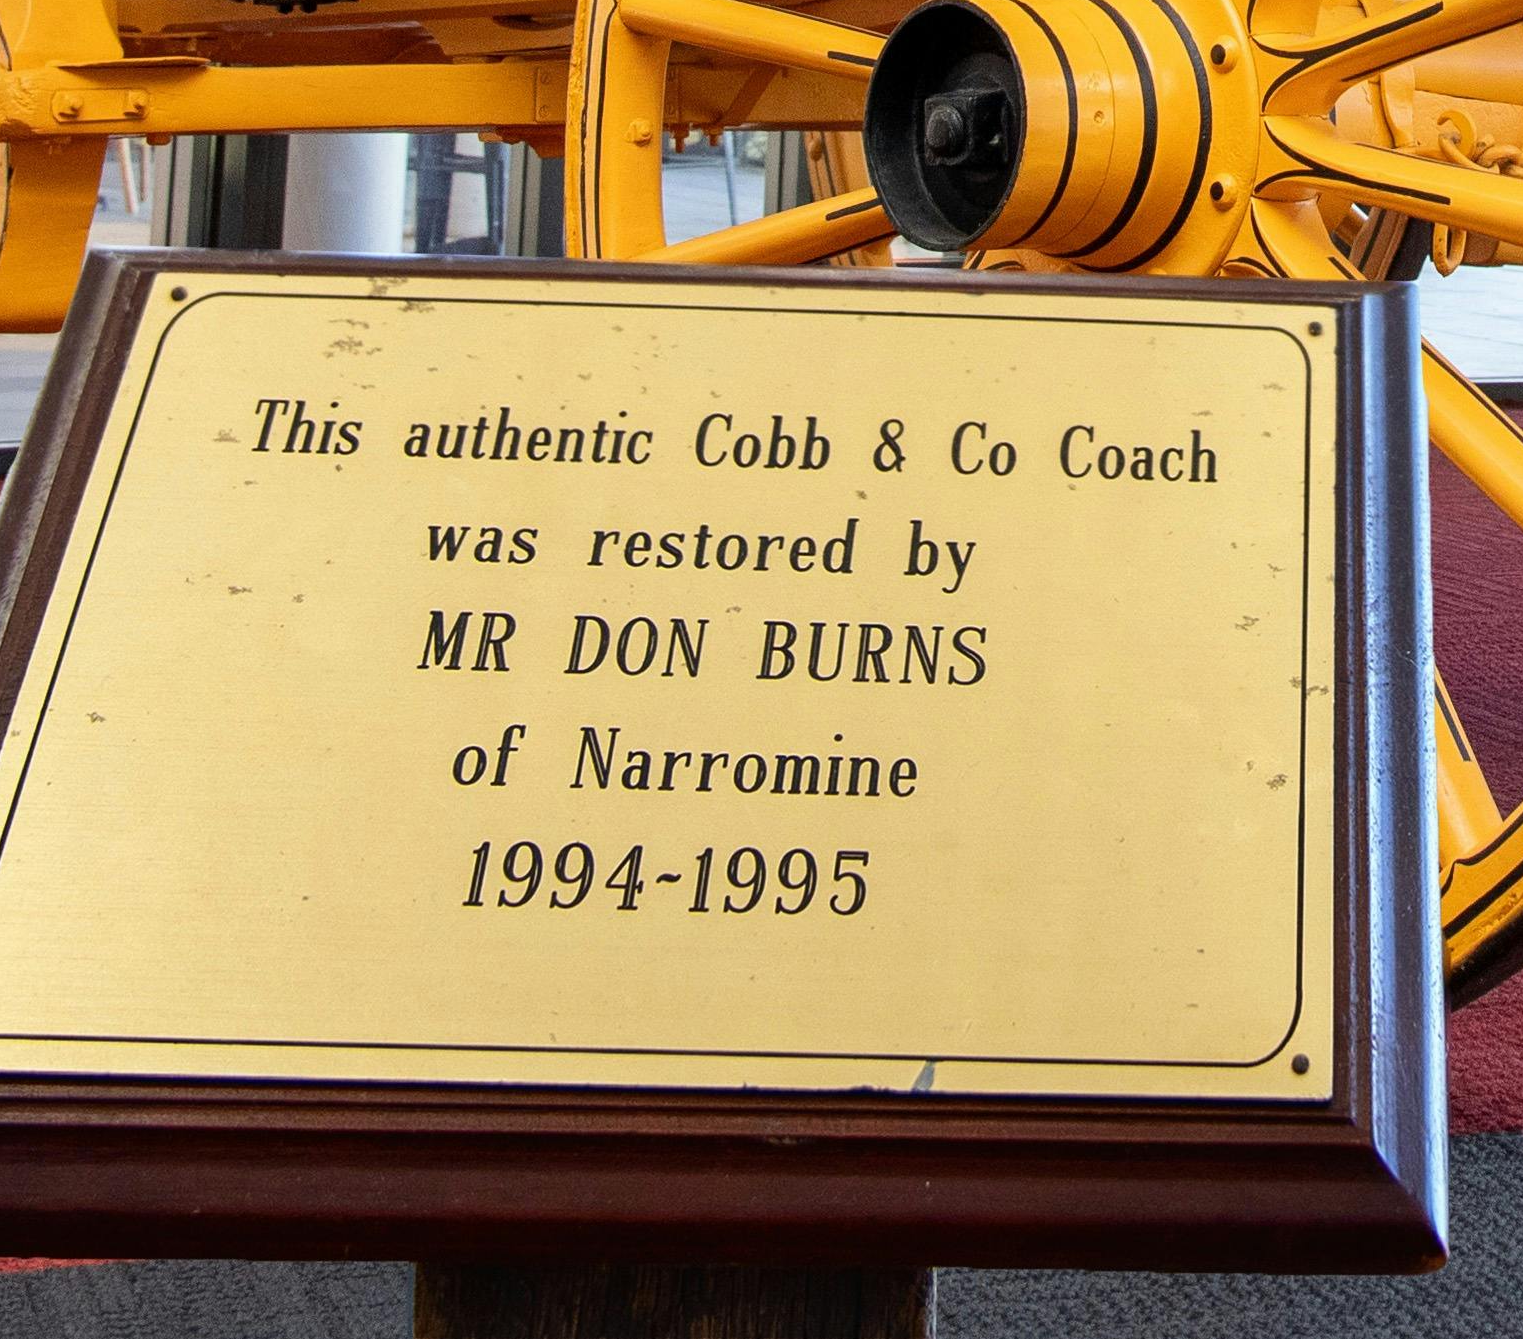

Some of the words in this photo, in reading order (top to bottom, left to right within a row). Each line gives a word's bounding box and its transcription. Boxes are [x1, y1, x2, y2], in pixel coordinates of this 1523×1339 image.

[252, 399, 362, 458] This
[404, 407, 653, 466] authentic
[695, 413, 831, 471] Cobb
[873, 419, 907, 473] &
[951, 421, 1018, 478] Co
[1059, 425, 1219, 483] Coach
[427, 524, 539, 566] was
[587, 518, 858, 575] restored
[903, 520, 977, 594] by
[416, 610, 516, 673] MR
[563, 615, 710, 679] DON
[755, 621, 989, 687] BURNS
[451, 724, 526, 788] of
[569, 727, 918, 799] Narromine
